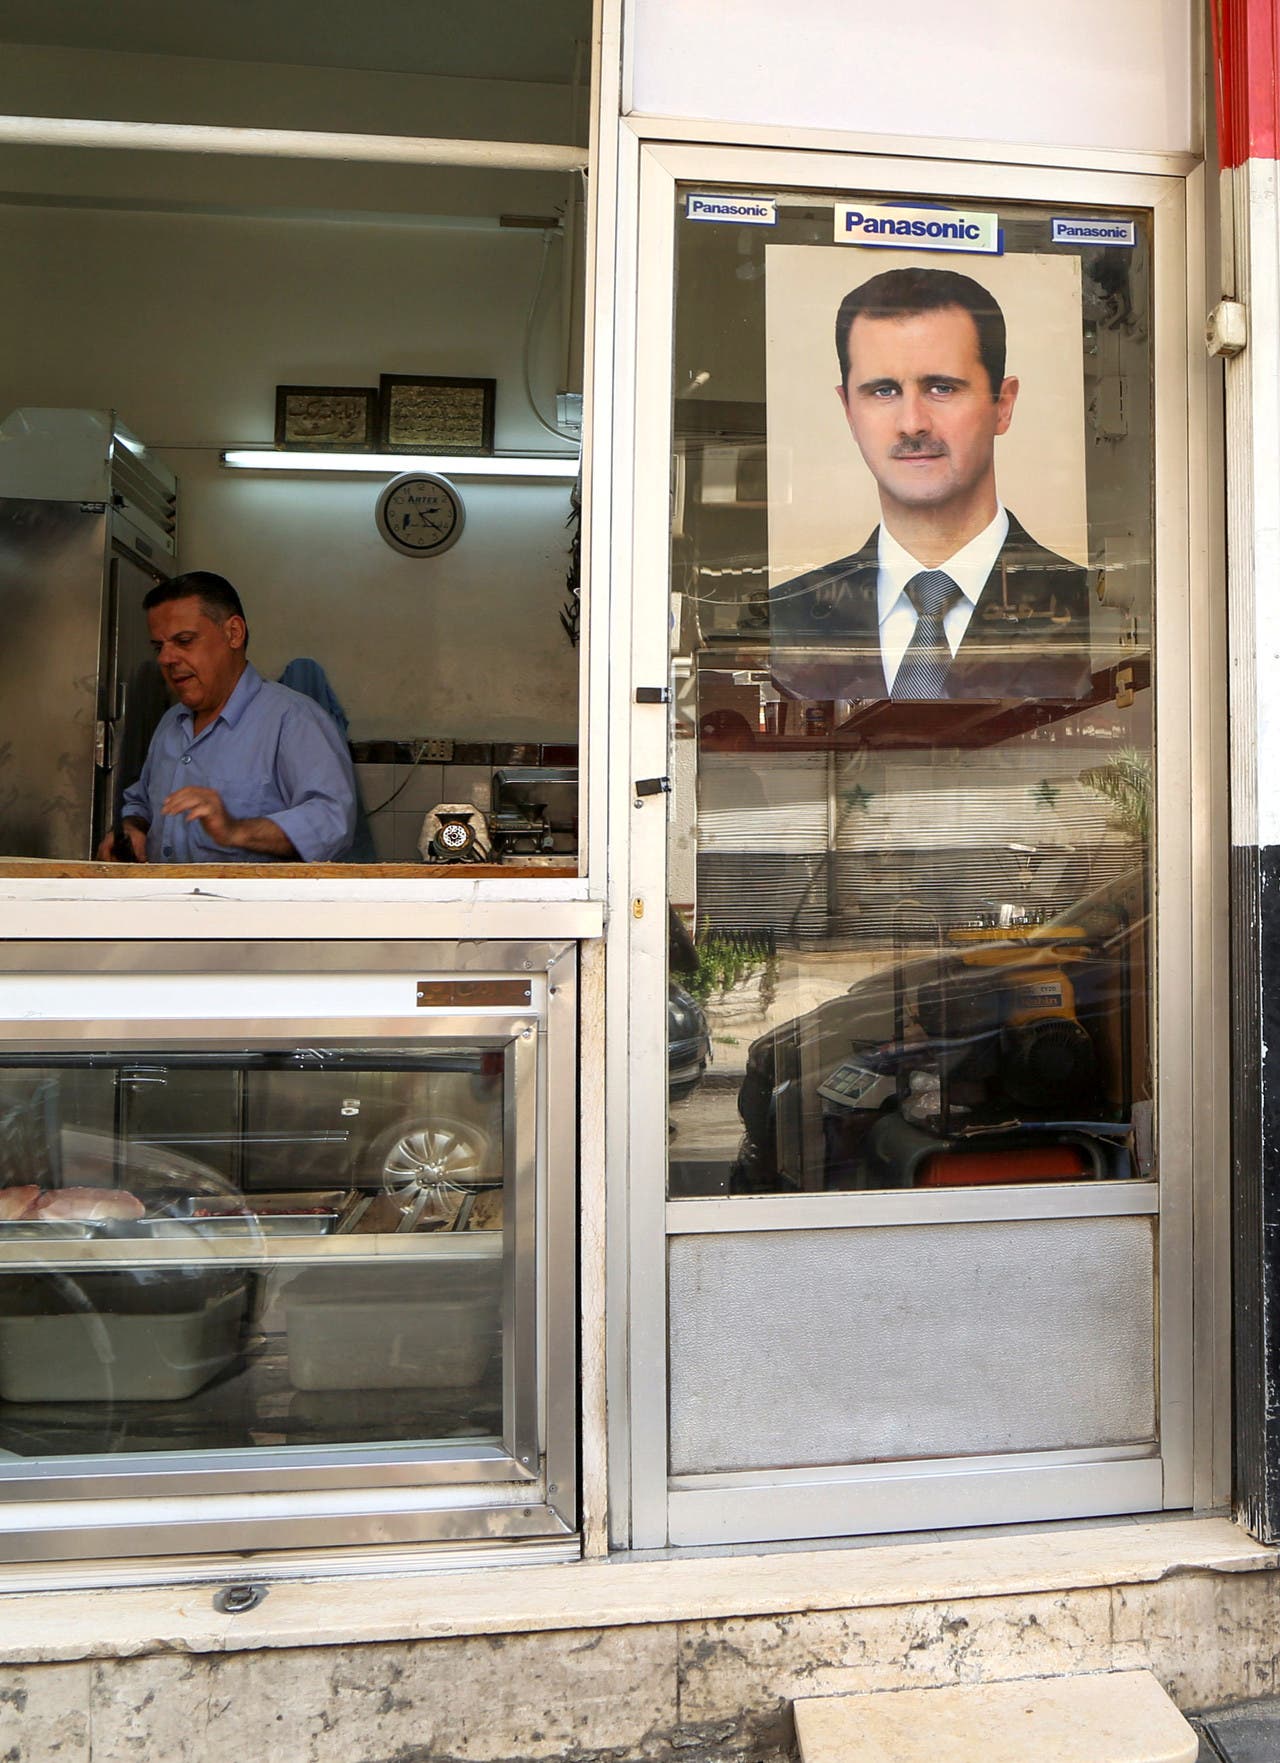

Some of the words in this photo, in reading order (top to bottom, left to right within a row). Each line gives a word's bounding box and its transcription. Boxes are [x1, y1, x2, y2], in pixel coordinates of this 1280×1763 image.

[692, 200, 768, 217] Panasonic
[845, 211, 980, 240] Panasonic
[1056, 223, 1128, 239] Panasonic
